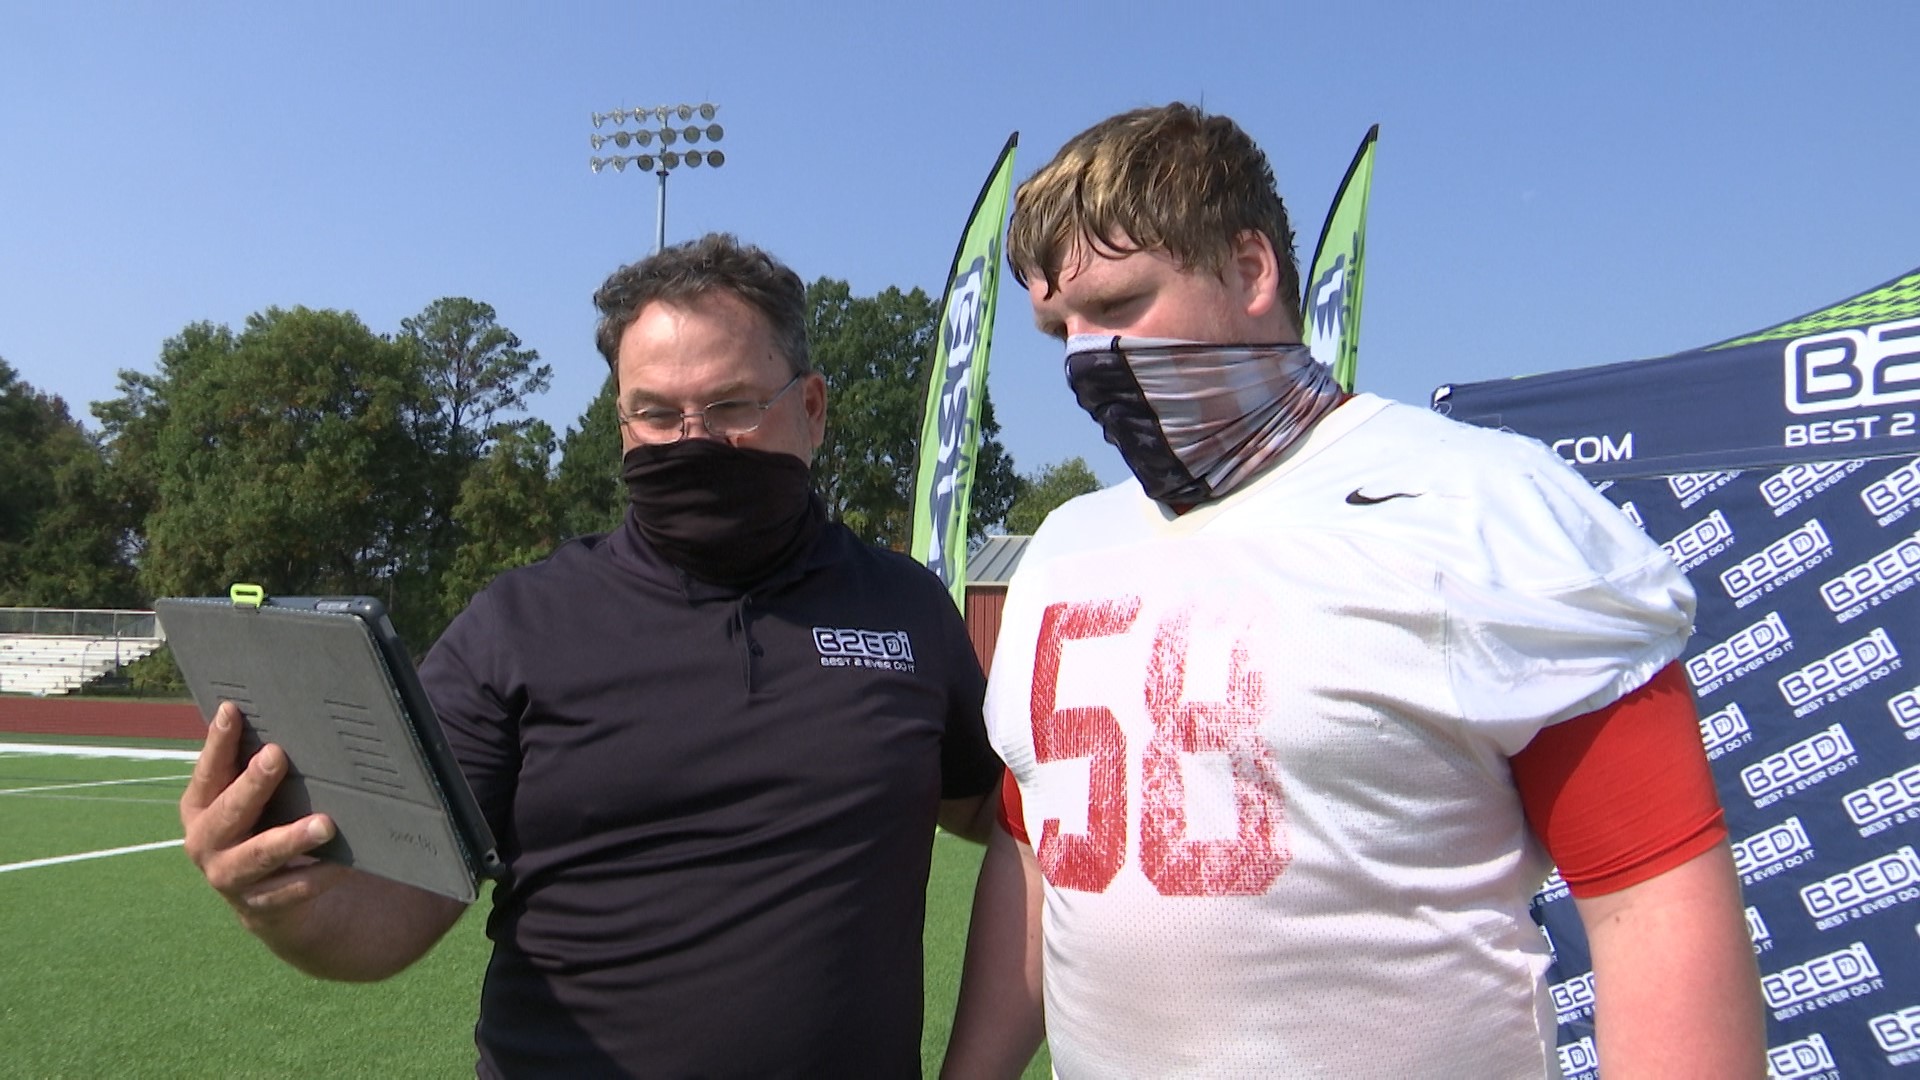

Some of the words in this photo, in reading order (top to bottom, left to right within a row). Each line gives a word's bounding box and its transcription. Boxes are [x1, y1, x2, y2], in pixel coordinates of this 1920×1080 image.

[1785, 415, 1880, 447] BEST
[1890, 412, 1916, 436] 2
[1820, 530, 1920, 612] B2ED
[820, 657, 850, 667] BEST
[864, 659, 892, 670] EVER
[893, 661, 907, 673] DO
[908, 664, 915, 674] IT
[1029, 594, 1292, 897] 58
[1795, 770, 1828, 790] EVER
[1847, 755, 1859, 766] IT
[1842, 763, 1920, 824] B2E
[1731, 816, 1812, 876] 2EDi
[1753, 863, 1785, 882] EVER
[1784, 855, 1803, 869] DO
[1803, 849, 1815, 860] IT
[1861, 894, 1898, 914] EVER
[1816, 989, 1850, 1008] EVER
[1849, 983, 1872, 996] DO
[1871, 978, 1884, 990] IT
[1767, 1033, 1836, 1080] EDi
